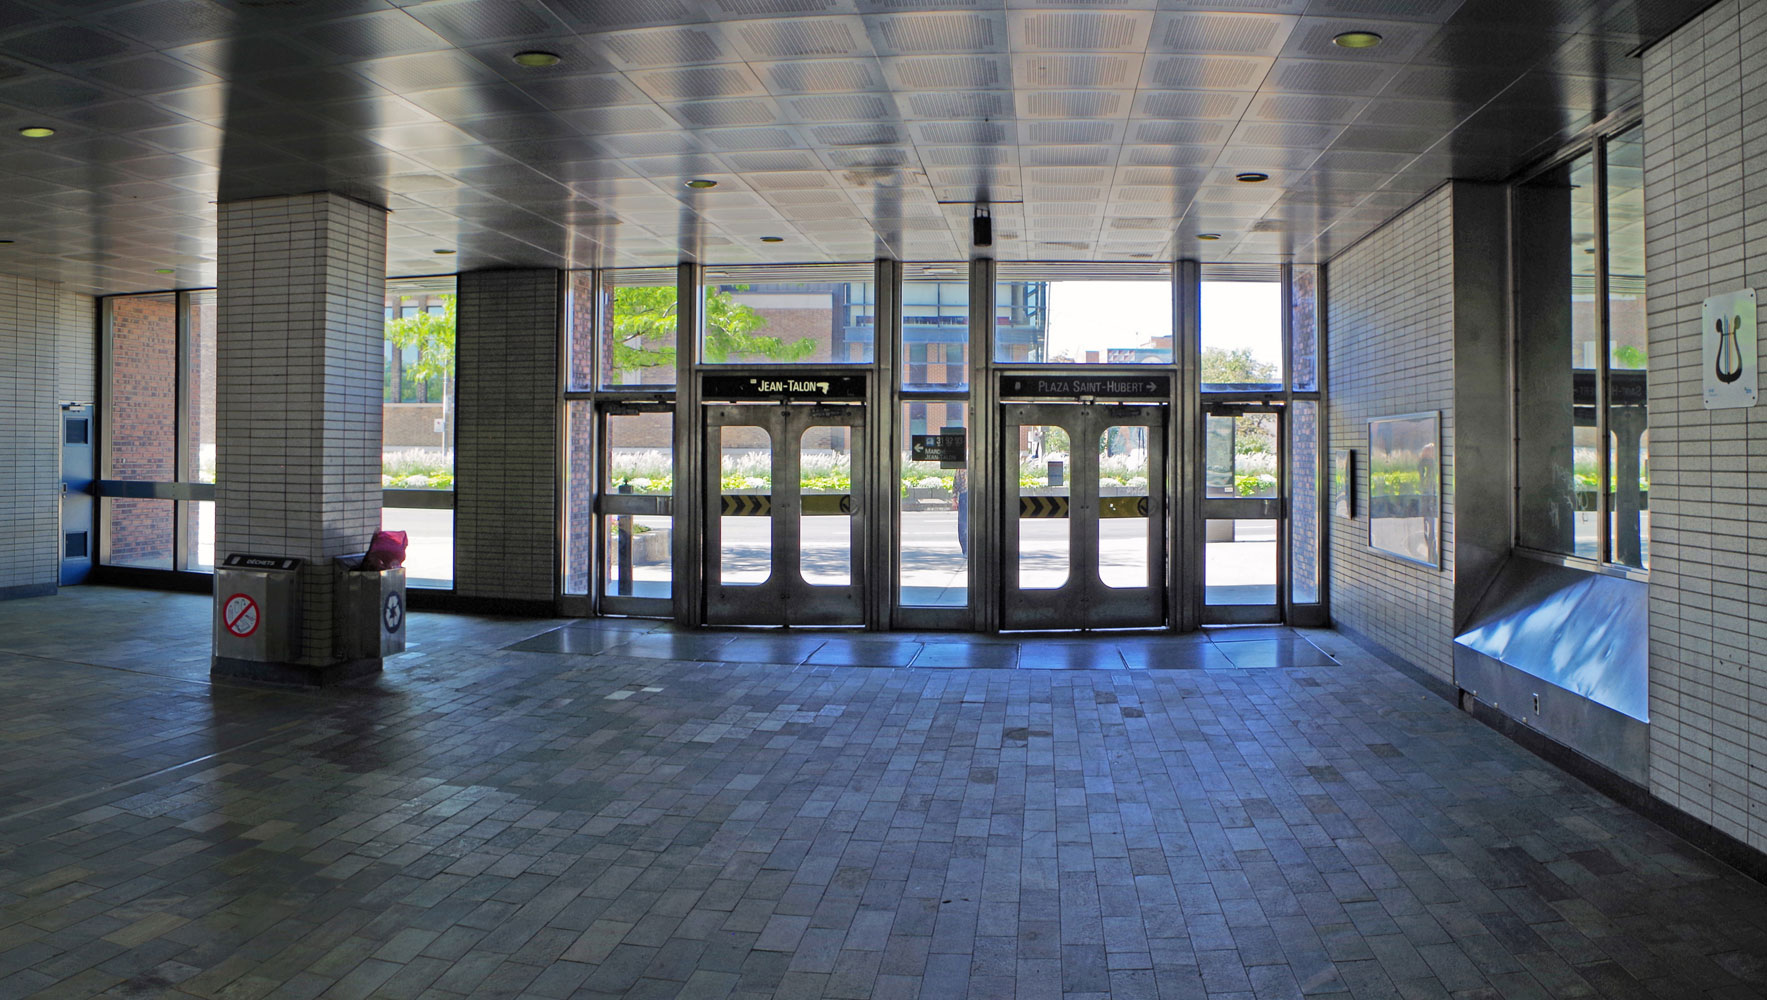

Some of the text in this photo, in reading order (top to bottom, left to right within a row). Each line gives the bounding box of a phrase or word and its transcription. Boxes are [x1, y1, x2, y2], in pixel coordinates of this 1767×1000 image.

[758, 380, 816, 392] JEAN-TALON
[1038, 380, 1143, 393] PLAZA SAINT-HUBERT
[246, 558, 275, 566] DÉCHETS
